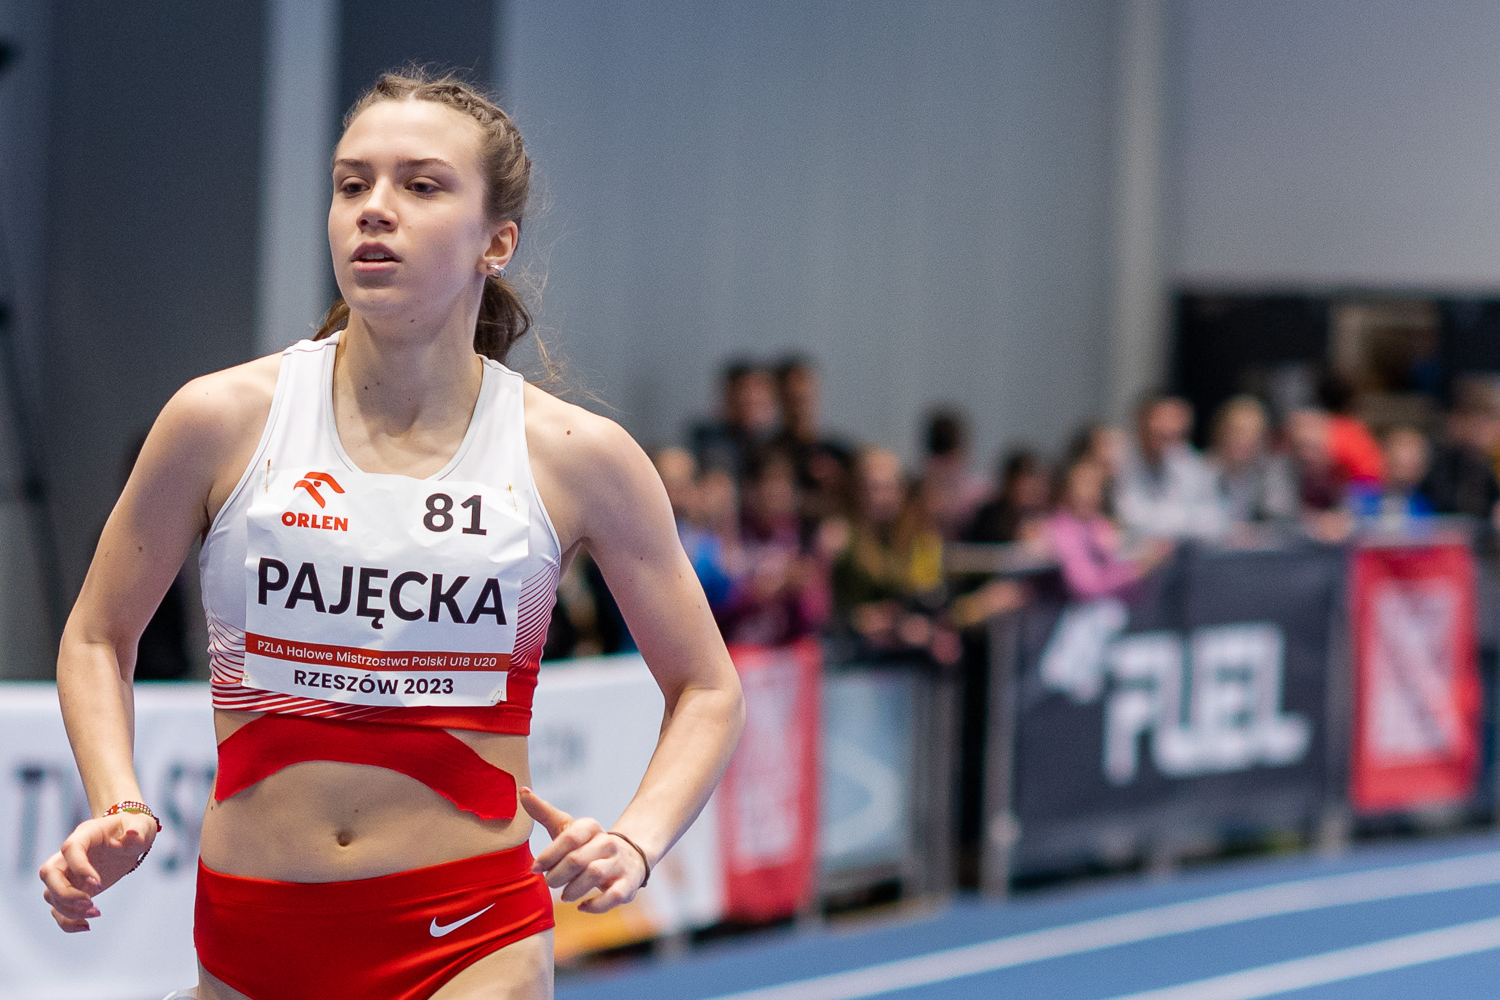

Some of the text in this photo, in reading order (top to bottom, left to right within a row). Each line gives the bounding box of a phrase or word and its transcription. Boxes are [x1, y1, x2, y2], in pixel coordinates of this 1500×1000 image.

[281, 511, 349, 532] ORLEN
[422, 492, 488, 536] 81
[257, 557, 508, 630] PAJĘCKA
[257, 640, 497, 667] PZLA Halowe Mistrzostwa Polski U18 U20
[294, 669, 454, 695] RZESZÓW 2023
[1104, 622, 1313, 786] FUEL
